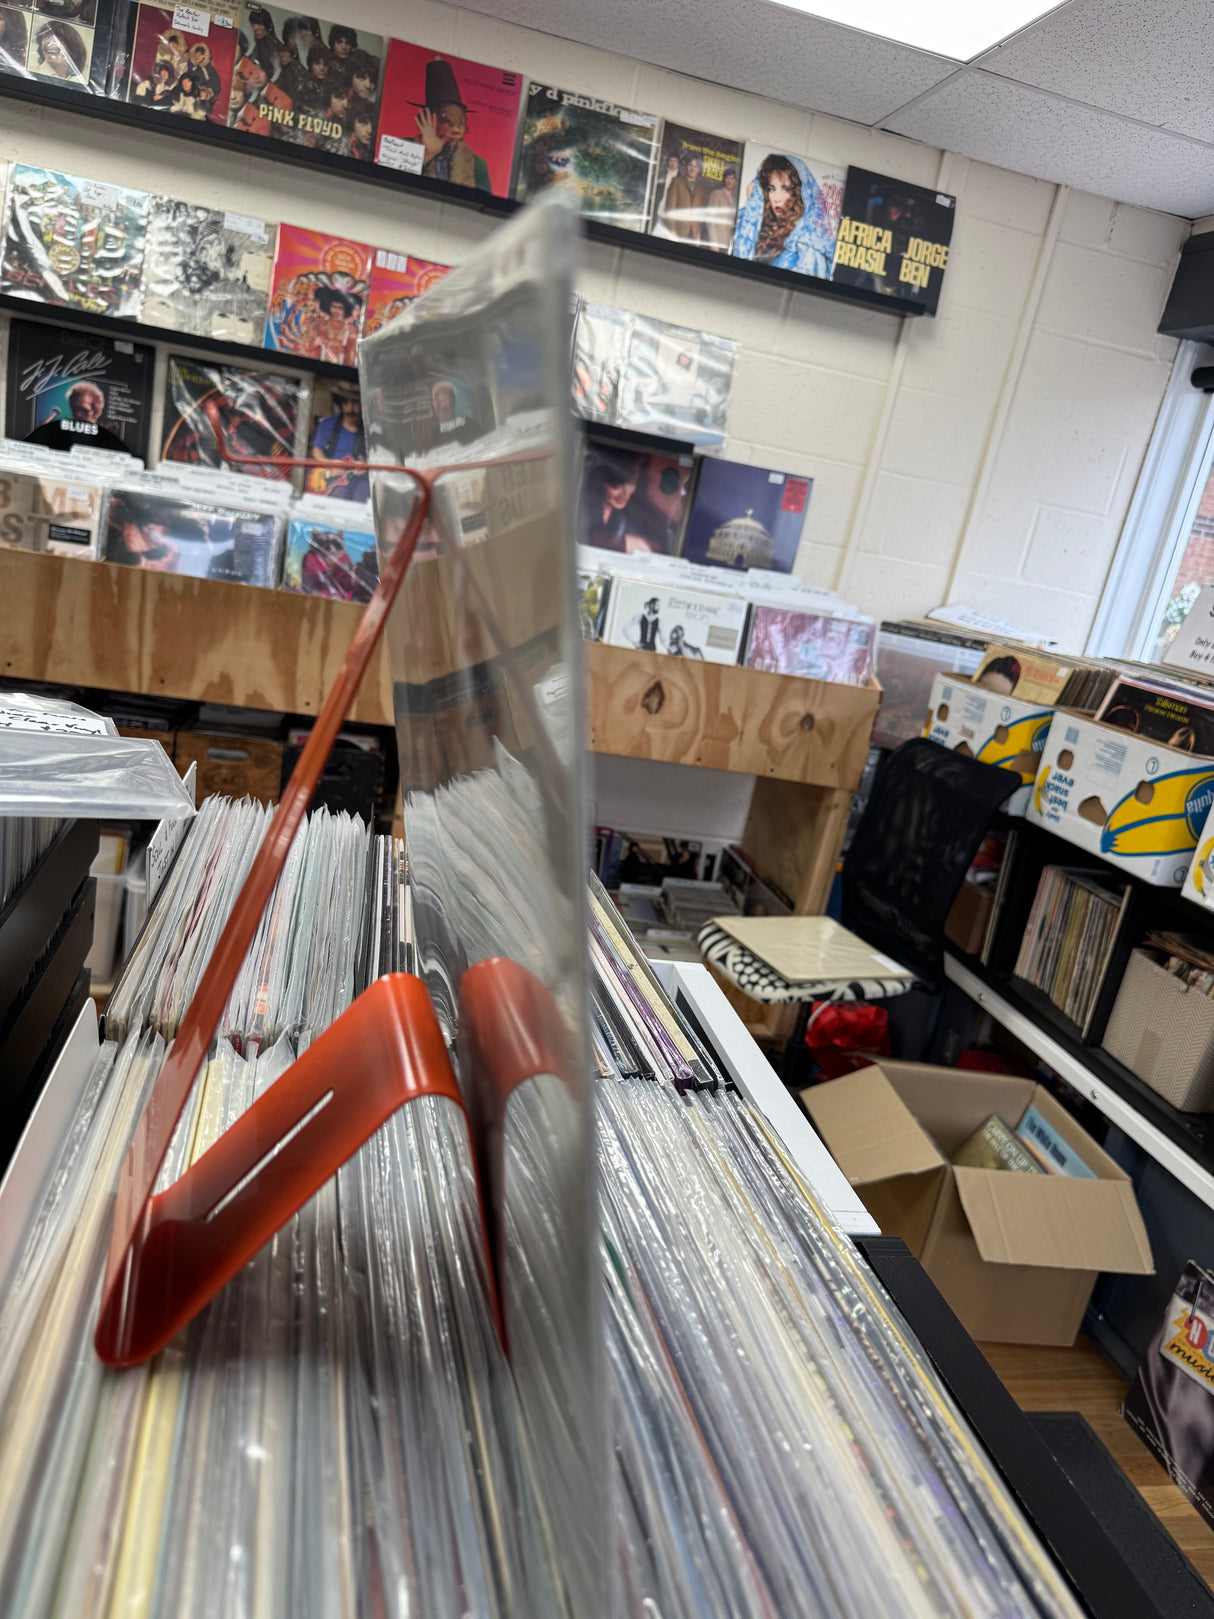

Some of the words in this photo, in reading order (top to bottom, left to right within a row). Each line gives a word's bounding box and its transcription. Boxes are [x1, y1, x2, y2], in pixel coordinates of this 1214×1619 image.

[298, 114, 343, 139] FLOYD
[838, 217, 893, 255] ÁFRICA
[904, 237, 949, 270] JORGE
[836, 241, 887, 277] BRASIL
[899, 259, 931, 289] BEN
[61, 419, 99, 436] BLUES
[1052, 771, 1075, 788] ever
[1045, 780, 1069, 798] snack
[1048, 794, 1068, 813] best
[1005, 1142, 1018, 1156] ON
